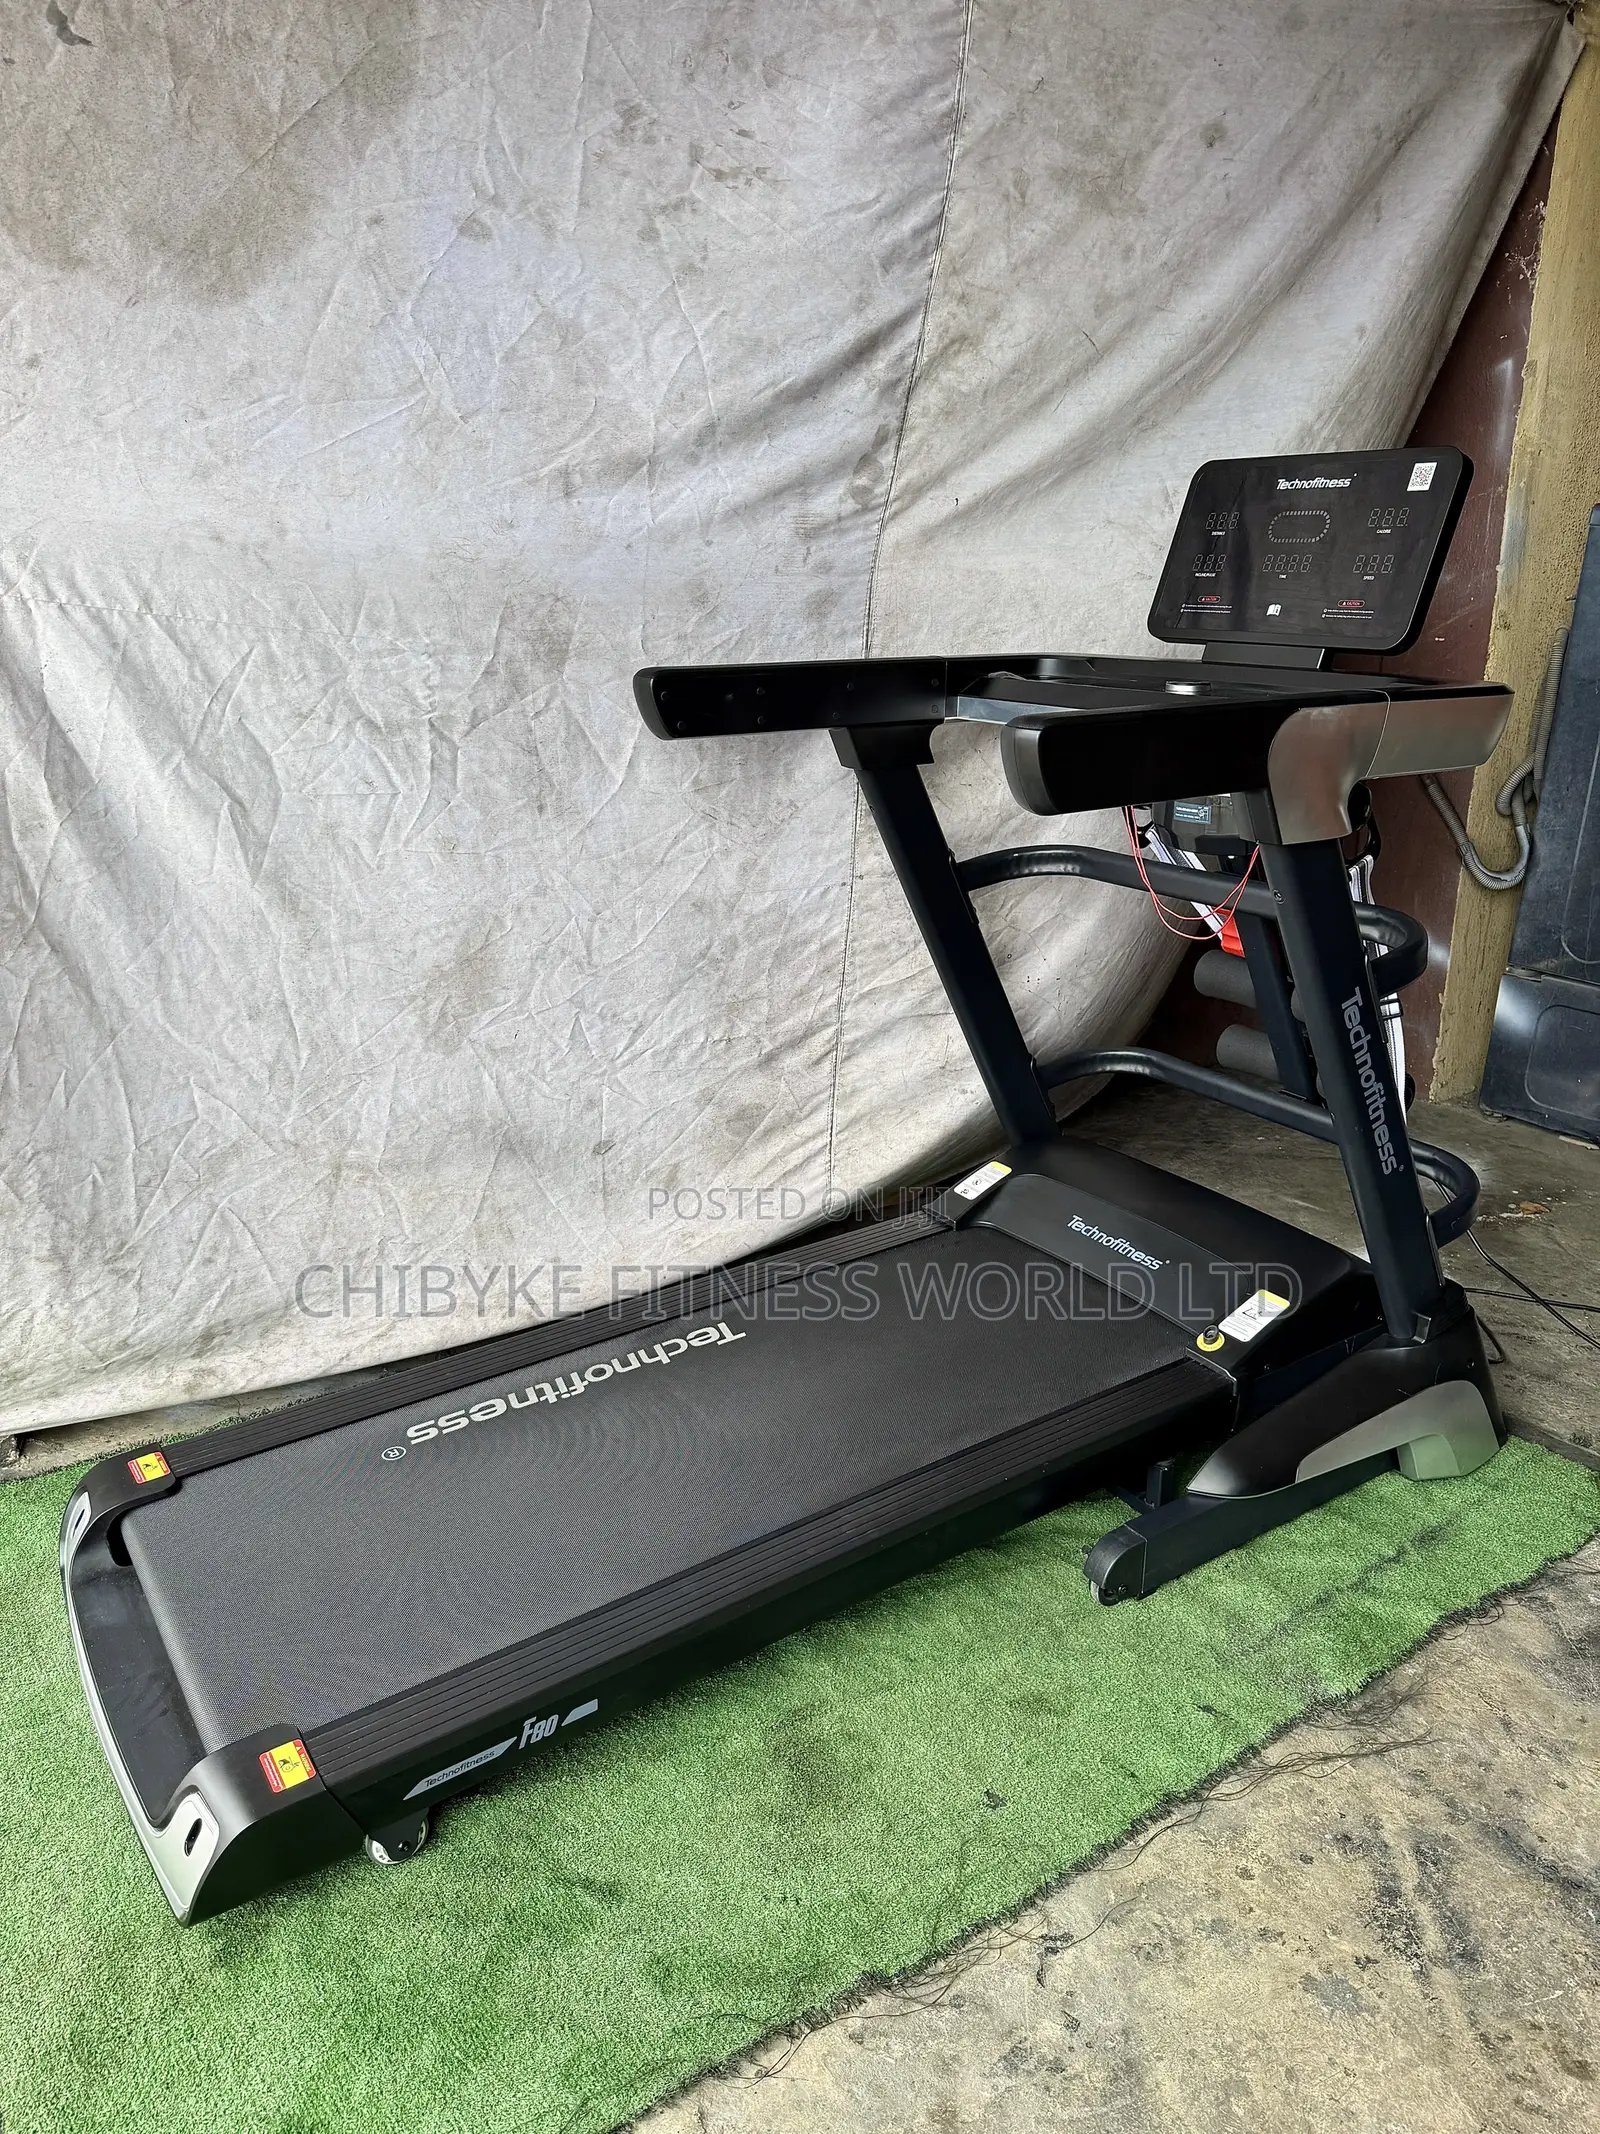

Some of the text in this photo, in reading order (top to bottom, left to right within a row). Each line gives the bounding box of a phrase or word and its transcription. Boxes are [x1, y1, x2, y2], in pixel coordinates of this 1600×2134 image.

[1276, 477, 1352, 491] Technofitness
[1341, 986, 1397, 1175] Technofitness
[1066, 1214, 1163, 1271] Technofitness
[406, 1321, 747, 1445] Technofitness
[519, 1714, 559, 1750] F80
[424, 1749, 496, 1788] Technofitness
